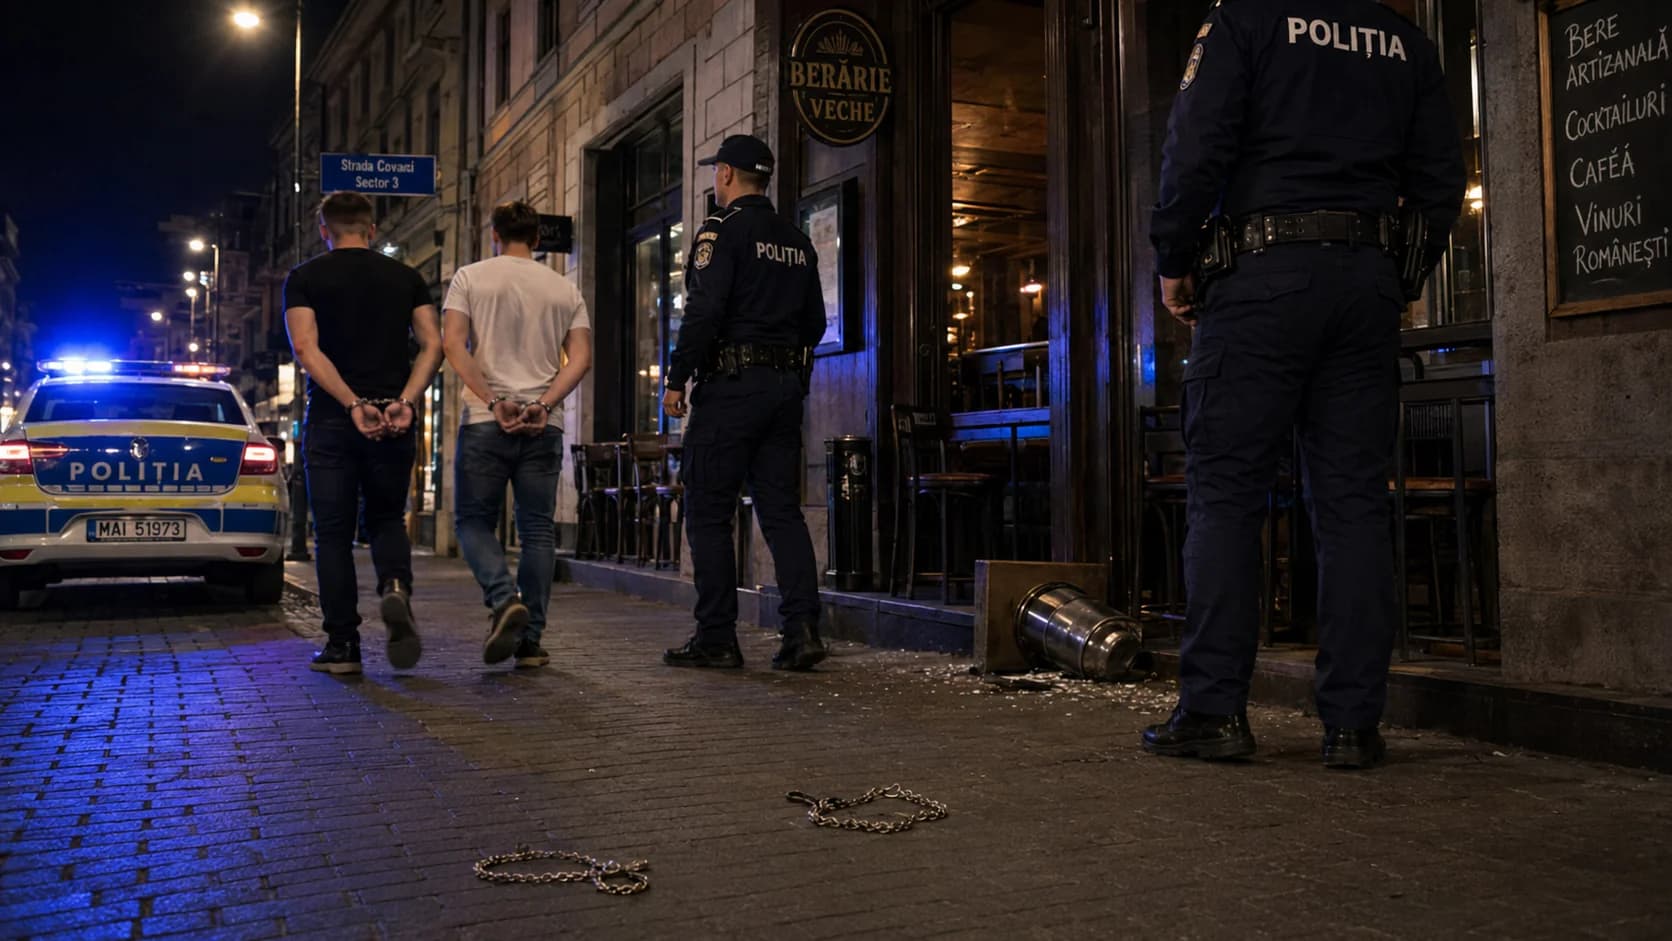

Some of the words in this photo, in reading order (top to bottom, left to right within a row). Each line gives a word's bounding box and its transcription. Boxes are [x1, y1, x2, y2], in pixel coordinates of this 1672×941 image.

[1287, 16, 1407, 61] POLIȚIA
[1564, 13, 1620, 59] BERE
[1566, 24, 1669, 91] ARTIZANALĂ
[790, 58, 892, 94] BERĂRIE
[810, 98, 875, 122] VECHE
[1565, 82, 1666, 141] COCKTAILURI
[341, 159, 373, 172] Strada
[355, 176, 389, 189] Sector
[392, 177, 399, 189] 3
[1574, 195, 1642, 237] VINURI
[756, 241, 807, 267] POLIȚIA
[99, 522, 127, 537] MAI
[135, 521, 181, 537] 51973
